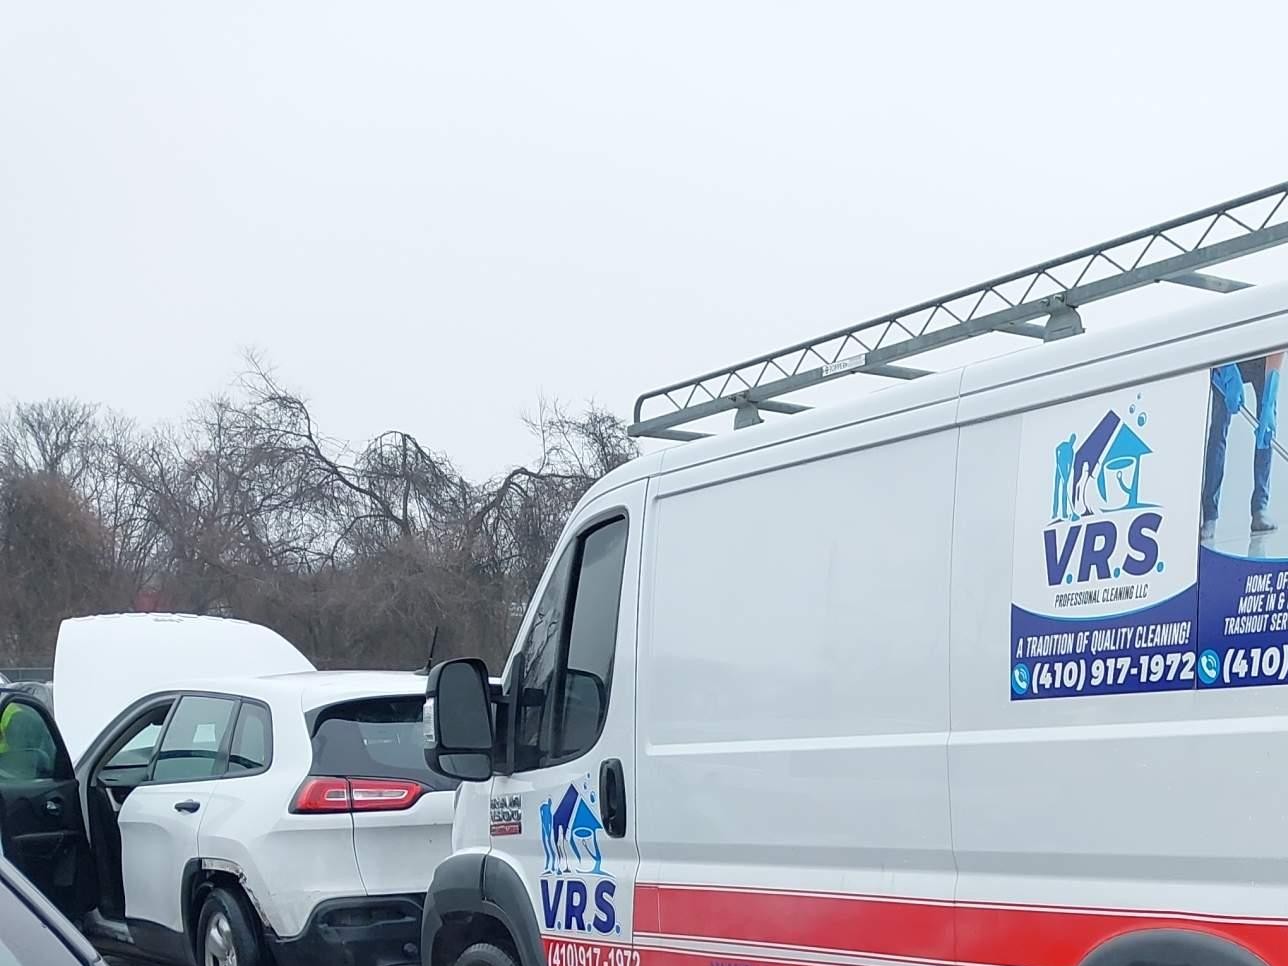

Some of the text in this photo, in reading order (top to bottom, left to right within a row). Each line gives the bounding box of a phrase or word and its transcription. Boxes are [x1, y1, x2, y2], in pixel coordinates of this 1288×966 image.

[1043, 512, 1165, 587] V.R.S.
[1054, 583, 1149, 608] PROFESSIONAL CLEANING LLC
[1245, 573, 1274, 594] HOME,
[1238, 594, 1265, 614] MOVE
[1265, 592, 1277, 612] IN
[1277, 592, 1286, 610] &
[1015, 621, 1192, 659] A TRADITION OF QUALITY CLEANING!
[1223, 614, 1270, 636] TRASHOUT
[1031, 651, 1197, 694] (410) 917-1972
[540, 879, 621, 934] V.R.S.
